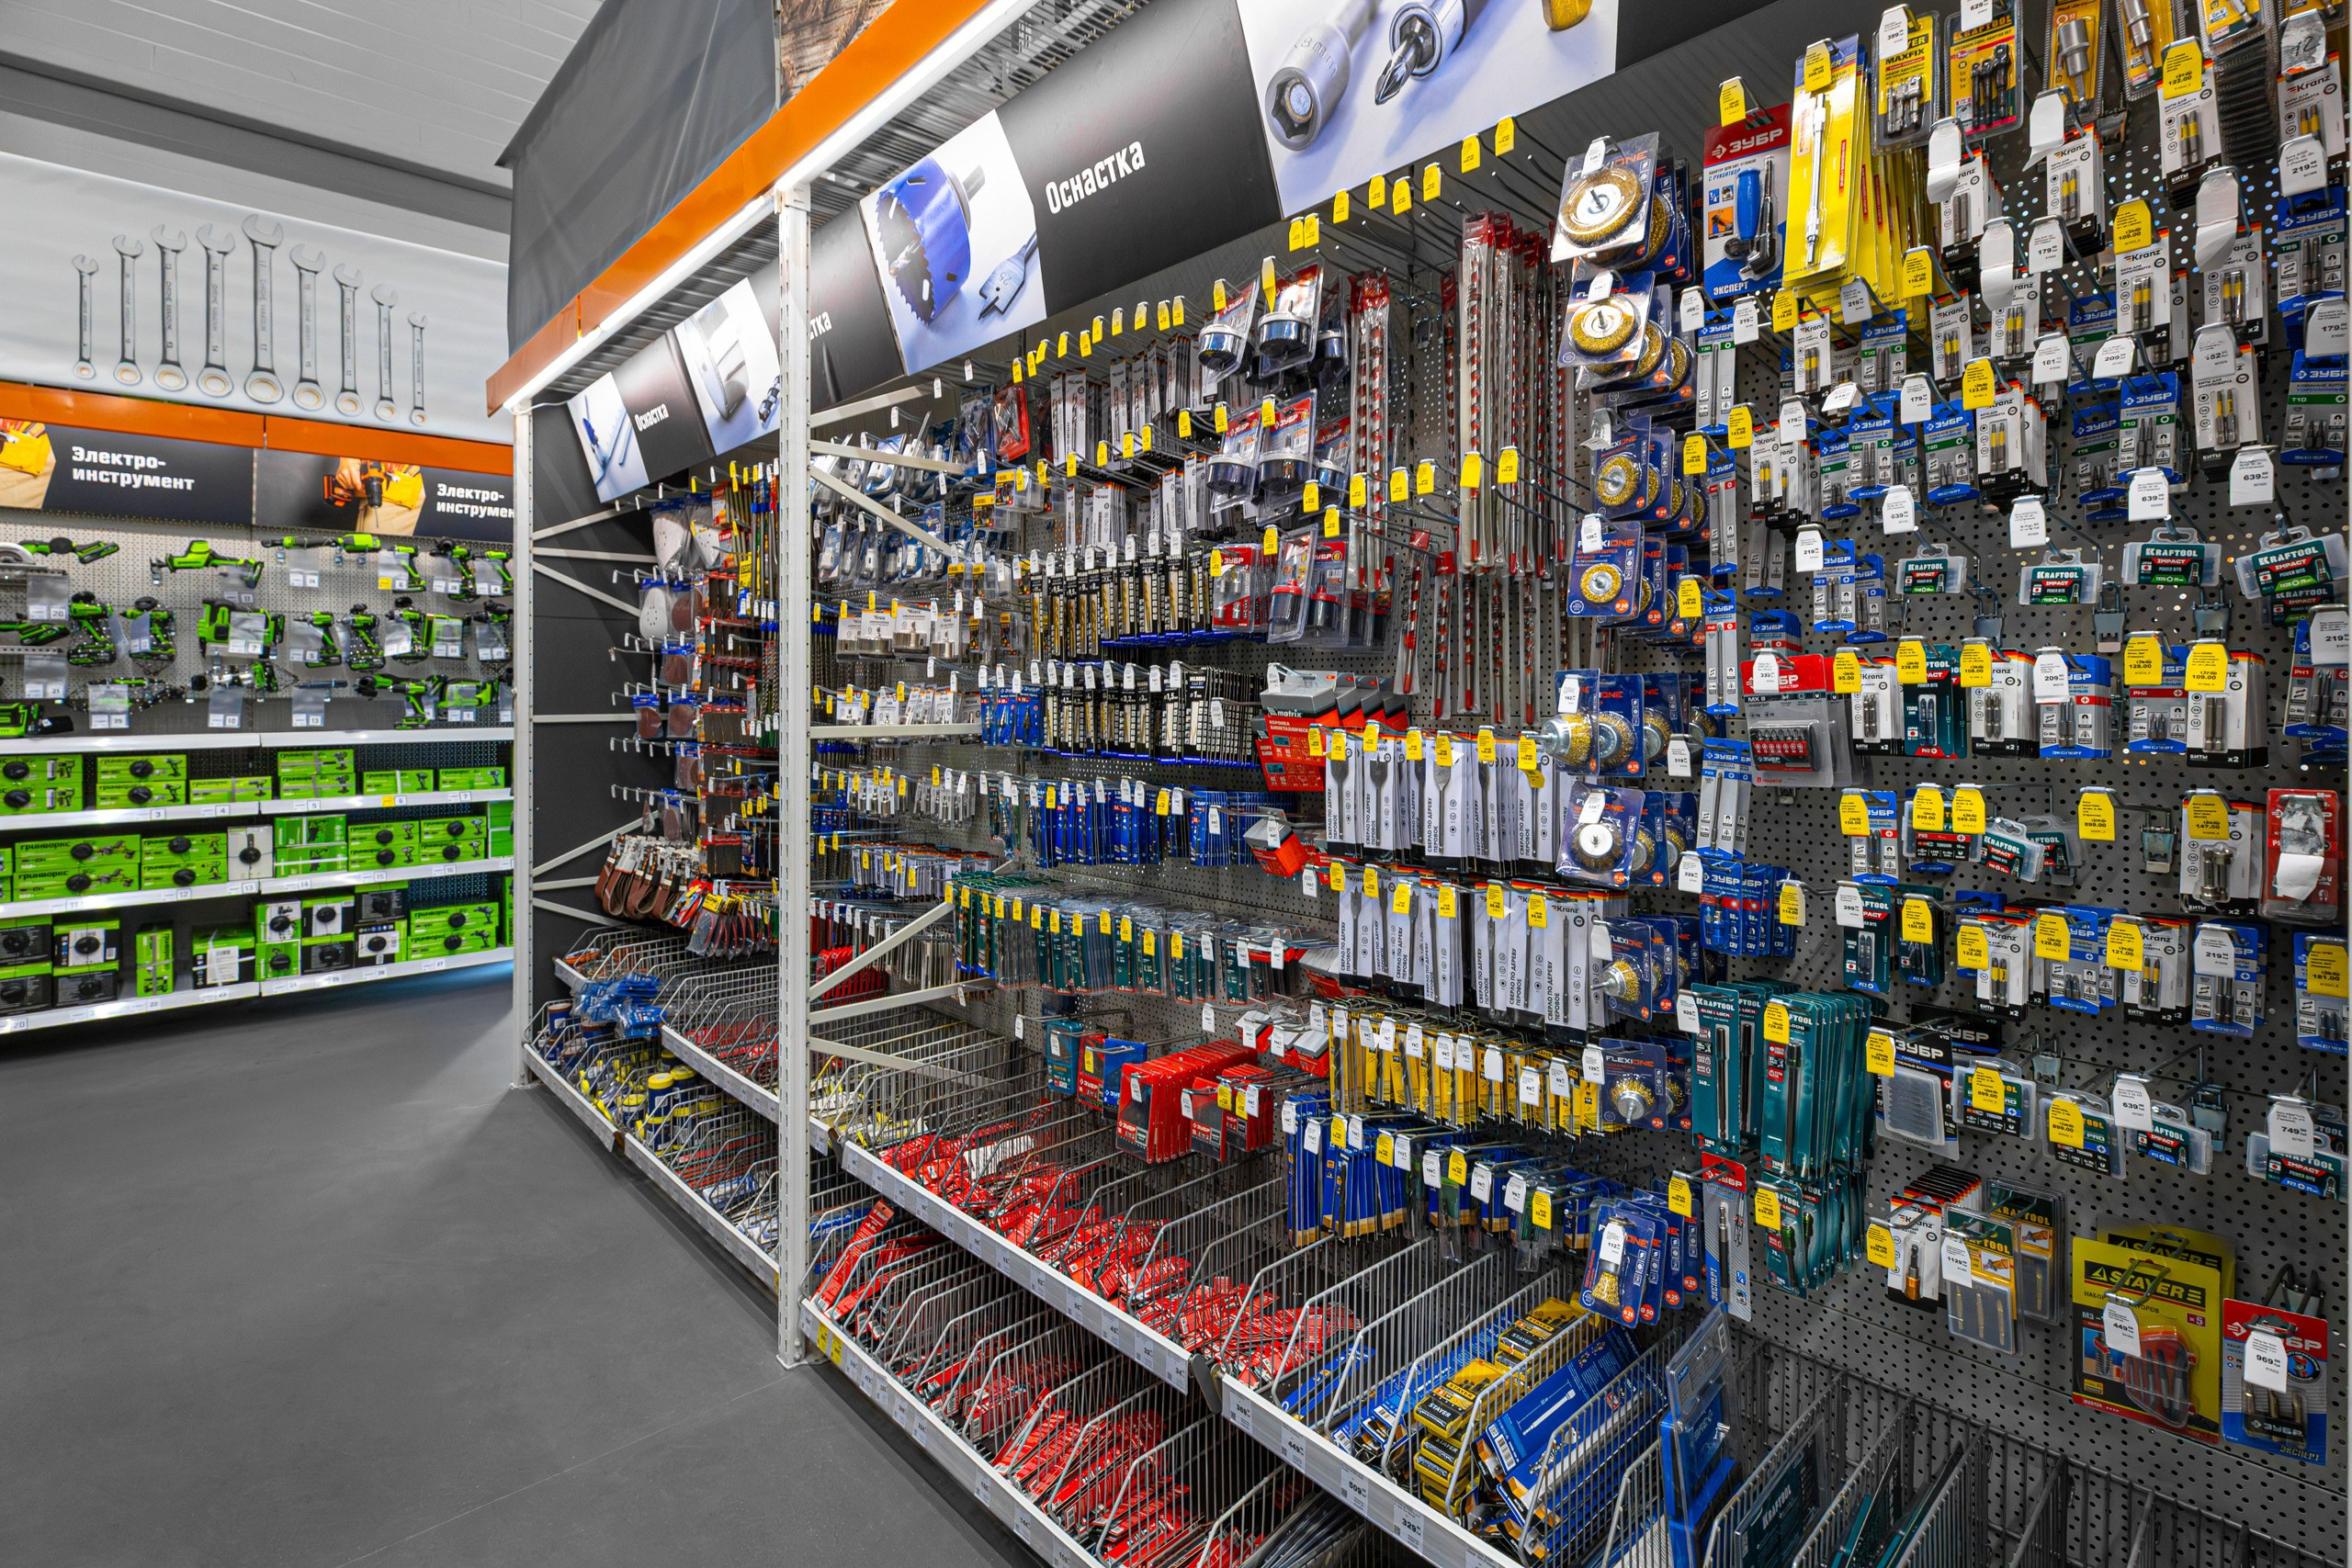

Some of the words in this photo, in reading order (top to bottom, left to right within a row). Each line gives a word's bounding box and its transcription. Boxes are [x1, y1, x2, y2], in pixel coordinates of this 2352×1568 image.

[1885, 48, 1925, 64] MAXFIX
[2297, 74, 2331, 92] Kranz
[1729, 129, 1782, 152] ЗУБР
[2061, 143, 2087, 158] Kranz
[1046, 141, 1146, 214] Оснастка
[2171, 173, 2188, 183] БИТЫ
[2296, 209, 2340, 223] ЗУБР
[2132, 249, 2161, 261] Kranz
[1713, 281, 1748, 295] ЭКСПЕРТ
[1942, 307, 1964, 318] Kranz
[2082, 310, 2116, 321] ЗУБР
[1709, 323, 1733, 332] ЗУБР
[1804, 323, 1825, 333] Kranz
[1871, 324, 1904, 334] ЗУБР
[2310, 369, 2349, 381] ЗУБР
[2136, 393, 2172, 403] ЗУБР
[635, 404, 669, 432] Оснастка
[1936, 417, 1963, 428] ЗУБР
[1861, 420, 1890, 429] ЗУБР
[2083, 420, 2116, 432] ЗУБР
[72, 446, 165, 468] Электро-
[1715, 464, 1734, 473] ЗУБР
[73, 468, 195, 491] инструмент
[436, 484, 504, 502] Электро-
[436, 502, 514, 517] инструмен
[1577, 539, 1635, 547] FXIONE
[2146, 548, 2198, 557] KRAFTOOL
[2258, 547, 2318, 565] KRAFTOOL
[2275, 559, 2306, 570] IMPACT
[2277, 588, 2327, 598] KRAFTOOL
[1277, 710, 1302, 718] matrix
[1427, 819, 1432, 829] ПО
[1519, 821, 1523, 832] ПО
[21, 841, 70, 851] гринворкс
[1984, 836, 2020, 853] KRAFTOOL
[1991, 847, 2011, 857] IMPACT
[18, 871, 68, 880] гринворкс
[1712, 874, 1740, 885] ЗУБР
[1557, 906, 1578, 914] Kranz
[2143, 934, 2171, 942] Kranz
[1547, 986, 1553, 996] ПО
[1696, 998, 1735, 1010] KRAFTOOL
[2061, 1001, 2087, 1010] ЭКСПЕРТ
[2206, 1025, 2238, 1033] ЭКСПЕРТ
[1895, 1040, 1943, 1059] ЗУБР
[1606, 1055, 1654, 1067] FLEXIONE
[2151, 1134, 2174, 1145] IMPACT
[2288, 1161, 2319, 1174] IMPACT
[1710, 1268, 1719, 1302] ЭКСПЕРТ
[2108, 1270, 2184, 1298] STAYER
[1527, 1315, 1552, 1331] STAYER
[1511, 1333, 1533, 1347] STAYER
[2256, 1354, 2273, 1365] 969
[1449, 1382, 1473, 1400] STAYER
[2084, 1399, 2102, 1409] MASTER
[1429, 1403, 1452, 1419] STAYER
[2263, 1423, 2302, 1437] ЗУБР
